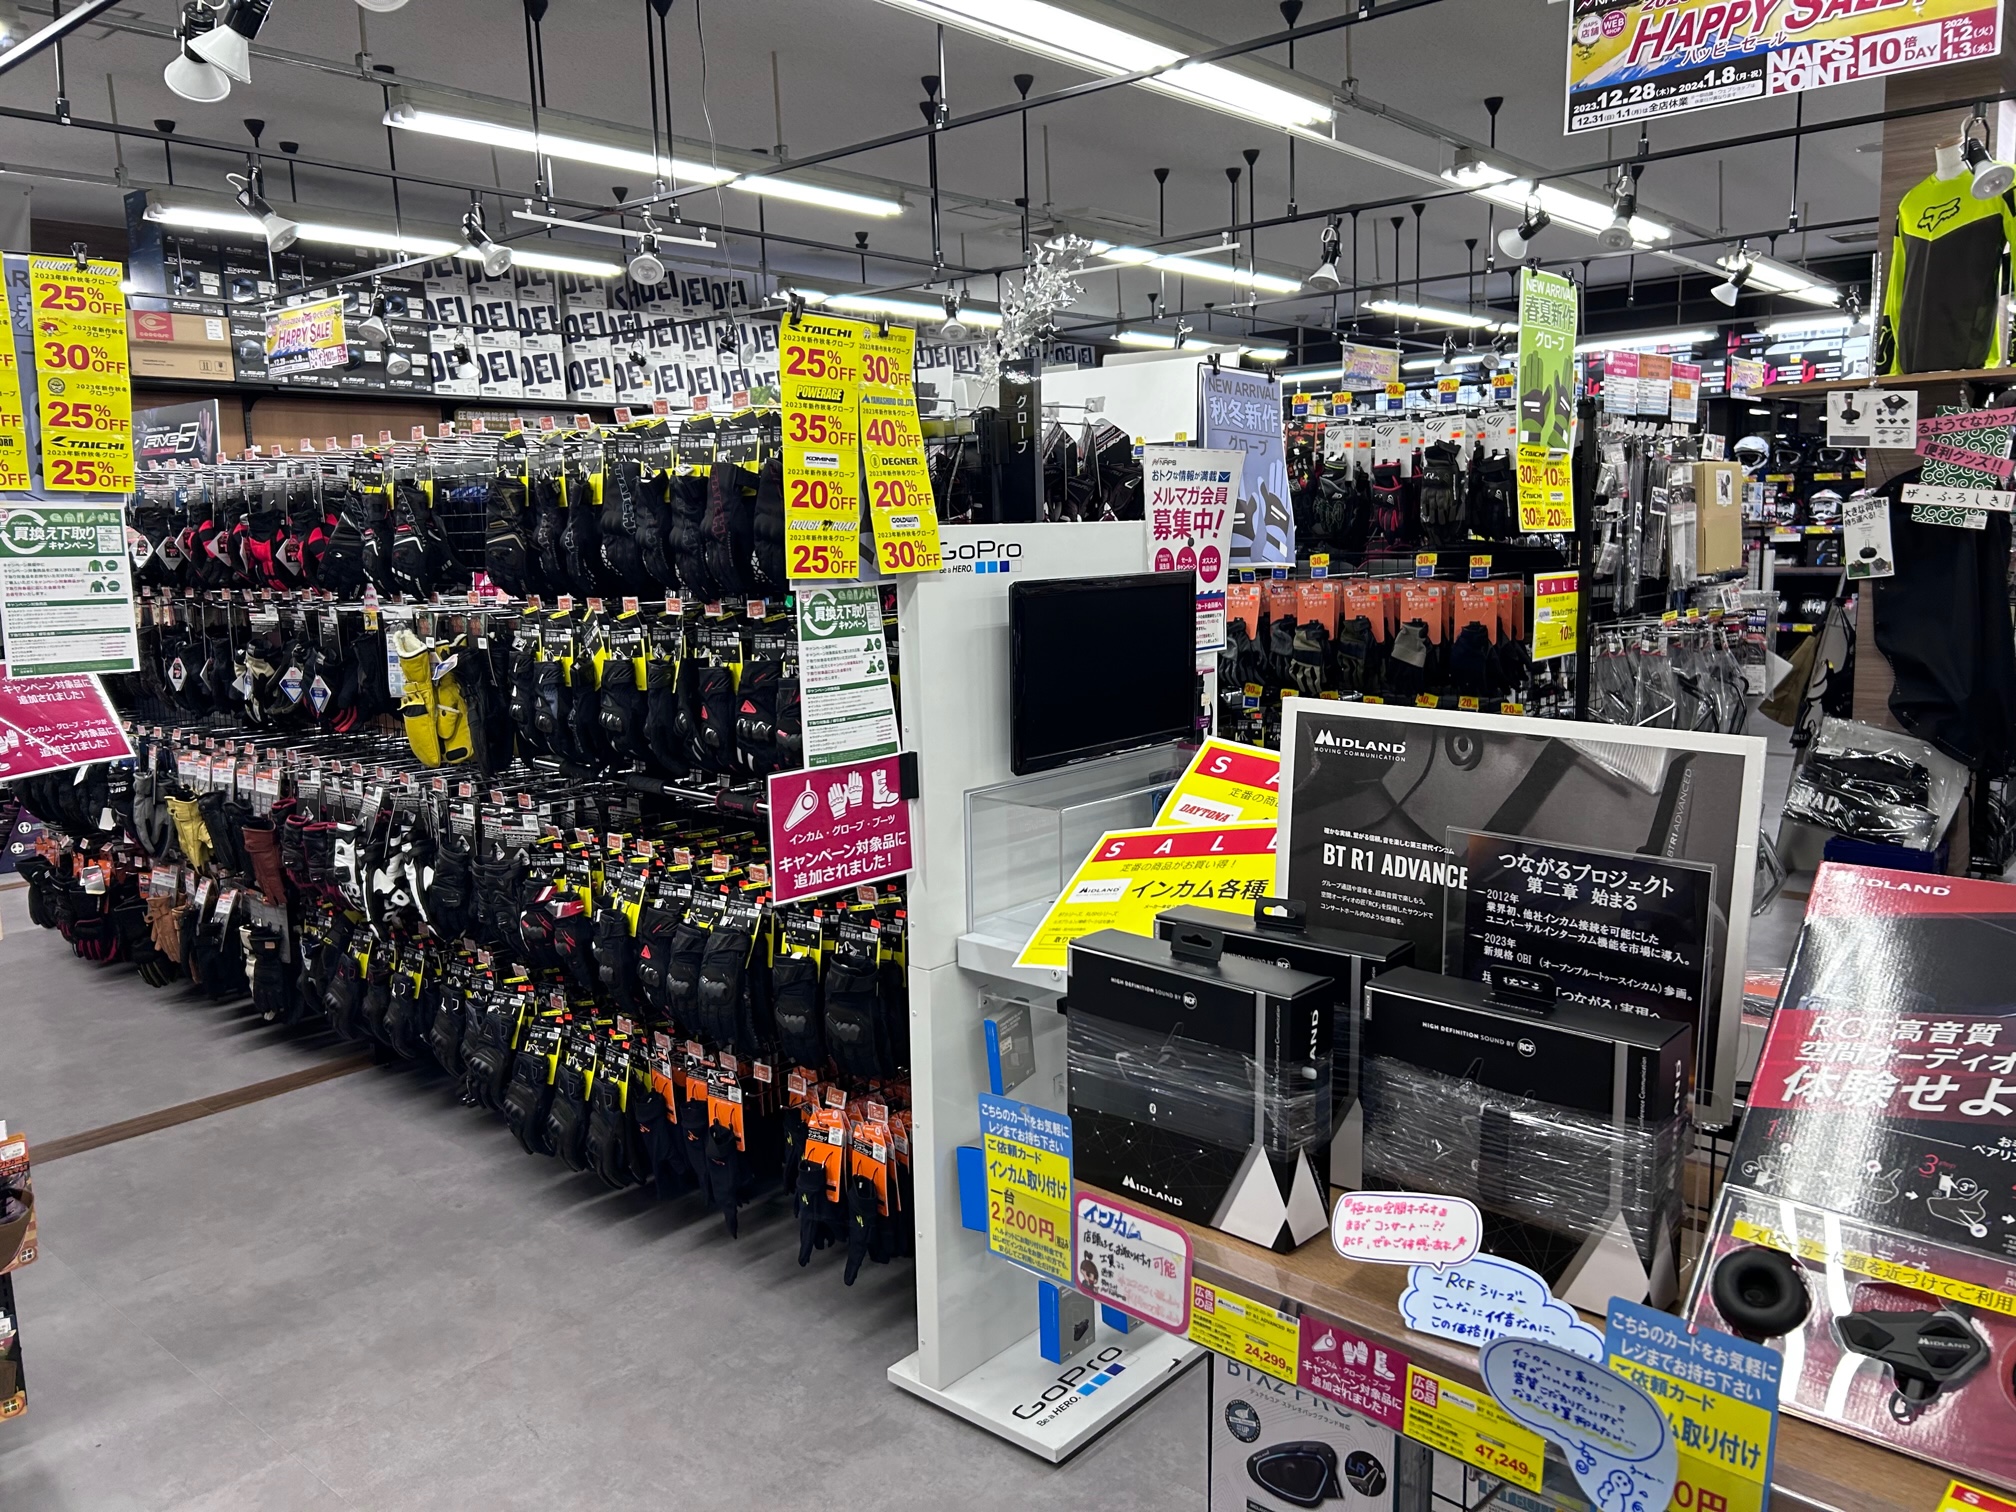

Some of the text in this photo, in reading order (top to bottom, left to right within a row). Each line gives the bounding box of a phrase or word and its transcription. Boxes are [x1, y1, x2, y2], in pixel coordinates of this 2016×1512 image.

[1581, 27, 1599, 38] 店舗
[1603, 19, 1625, 29] WEB
[1626, 0, 1780, 66] HAPPY
[1681, 32, 1786, 67] ハッピーセール
[1767, 37, 1854, 72] NAPS
[1862, 36, 1917, 68] 10 倍
[1905, 46, 1938, 61] DAY
[1771, 58, 1854, 94] POINT
[35, 273, 118, 286] 2023年新作秋冬グローブ
[227, 266, 261, 275] Explorer
[39, 283, 104, 312] 25%
[1526, 278, 1575, 302] NEW ARRIVAL
[89, 302, 123, 315] OFF
[1524, 296, 1575, 331] 春夏新作
[86, 331, 112, 339] グローブ
[278, 326, 308, 348] HAPPY
[783, 335, 855, 348] 2023年新作秋冬グローブ
[802, 325, 853, 339] TAICHI
[1535, 332, 1565, 351] グローブ
[43, 341, 107, 370] 30%
[92, 360, 126, 374] OFF
[862, 354, 900, 385] 30%
[796, 385, 844, 401] POWERAGE
[1208, 377, 1279, 401] NEW ARRIVAL
[48, 402, 111, 429] 25%
[1209, 396, 1280, 433] 秋冬新作
[95, 419, 129, 431] OFF
[789, 413, 842, 443] 35%
[866, 419, 907, 447] 40%
[47, 450, 129, 459] 2023年新作秋冬グローブ
[67, 440, 124, 450] TAICHI
[882, 457, 919, 466] DEGNER
[1924, 443, 2004, 473] 便利グッズ!!
[52, 460, 114, 486] 25%
[99, 475, 132, 488] OFF
[1152, 470, 1217, 482] おトクな情報が満載
[791, 480, 843, 509] 20%
[873, 480, 918, 508] 20%
[1152, 486, 1228, 506] メルマガ会員
[1844, 500, 1888, 518] 大きな荷物を
[1845, 511, 1877, 526] 持ち運べる!
[788, 519, 858, 531] ROUGH ROAD
[891, 517, 919, 525] GOLDWIN
[1153, 508, 1225, 541] 募集中!
[14, 526, 95, 541] 買換え下取り
[49, 541, 95, 550] キャンペーン
[883, 541, 927, 569] 30%
[939, 541, 1022, 560] GoPro
[1539, 580, 1578, 593] SALE
[814, 604, 866, 622] 買換え下取り
[838, 620, 867, 630] キャンペーン
[2, 679, 93, 694] キャンペーン対象品に
[17, 690, 86, 705] 追加されました!
[40, 739, 110, 758] 追加されました!
[1315, 729, 1407, 754] MIDLAND
[1314, 747, 1406, 762] MOVING COMMUNICATION
[1673, 767, 1694, 832] ADVANCED
[1179, 804, 1232, 822] DAYTONA
[789, 814, 896, 845] インカム・グローブ・ブーツ
[779, 831, 907, 873] キャンペーン対象品に
[793, 853, 892, 890] 追加されました!
[1120, 859, 1237, 873] 定番の商品がお買い得!
[1323, 843, 1468, 890] BT R1 ADVANCE
[1498, 852, 1674, 898] つながるプロジェクト
[1078, 886, 1120, 894] MIDLAND
[1132, 879, 1269, 900] インカム各種
[1486, 889, 1519, 904] 2012年
[1526, 876, 1639, 911] 第二章 始まる
[1484, 933, 1517, 948] 2023年
[1483, 946, 1514, 961] 新規格
[1516, 952, 1532, 965] OBI
[1110, 977, 1124, 985] HIGH
[1125, 980, 1154, 993] DEFINITION
[1155, 988, 1173, 998] SOUND
[1184, 996, 1196, 1006] RCF
[1422, 1022, 1515, 1048] HIGH DEFINITION SOUND BY
[1808, 1015, 2003, 1047] RCF高音質
[1518, 1042, 1534, 1053] RCF
[1781, 1065, 2016, 1117] 体験せよ
[981, 1103, 1069, 1138] こちらのカードをお気軽に
[988, 1121, 1064, 1153] レジまでお持ち下さい
[988, 1138, 1042, 1165] ご依頼カード
[989, 1160, 1067, 1200] インカム取り付け
[990, 1188, 1015, 1205] 一台
[1122, 1176, 1183, 1207] MIDLAND
[991, 1201, 1055, 1242] 2,200円
[1083, 1204, 1142, 1240] インカム
[1153, 1256, 1177, 1279] 可能
[1195, 1285, 1214, 1301] 広告
[1194, 1298, 1214, 1312] の品
[1612, 1311, 1778, 1383] こちらのカードをお気軽に
[1314, 1356, 1391, 1391] インカム・グローブ・ブーツ
[1621, 1339, 1762, 1400] レジまでお持ち下さい
[1012, 1347, 1123, 1420] GoPro
[1413, 1374, 1437, 1392] 広告
[1412, 1388, 1436, 1407] の品
[1036, 1416, 1050, 1427] Be
[1348, 1457, 1366, 1476] LR
